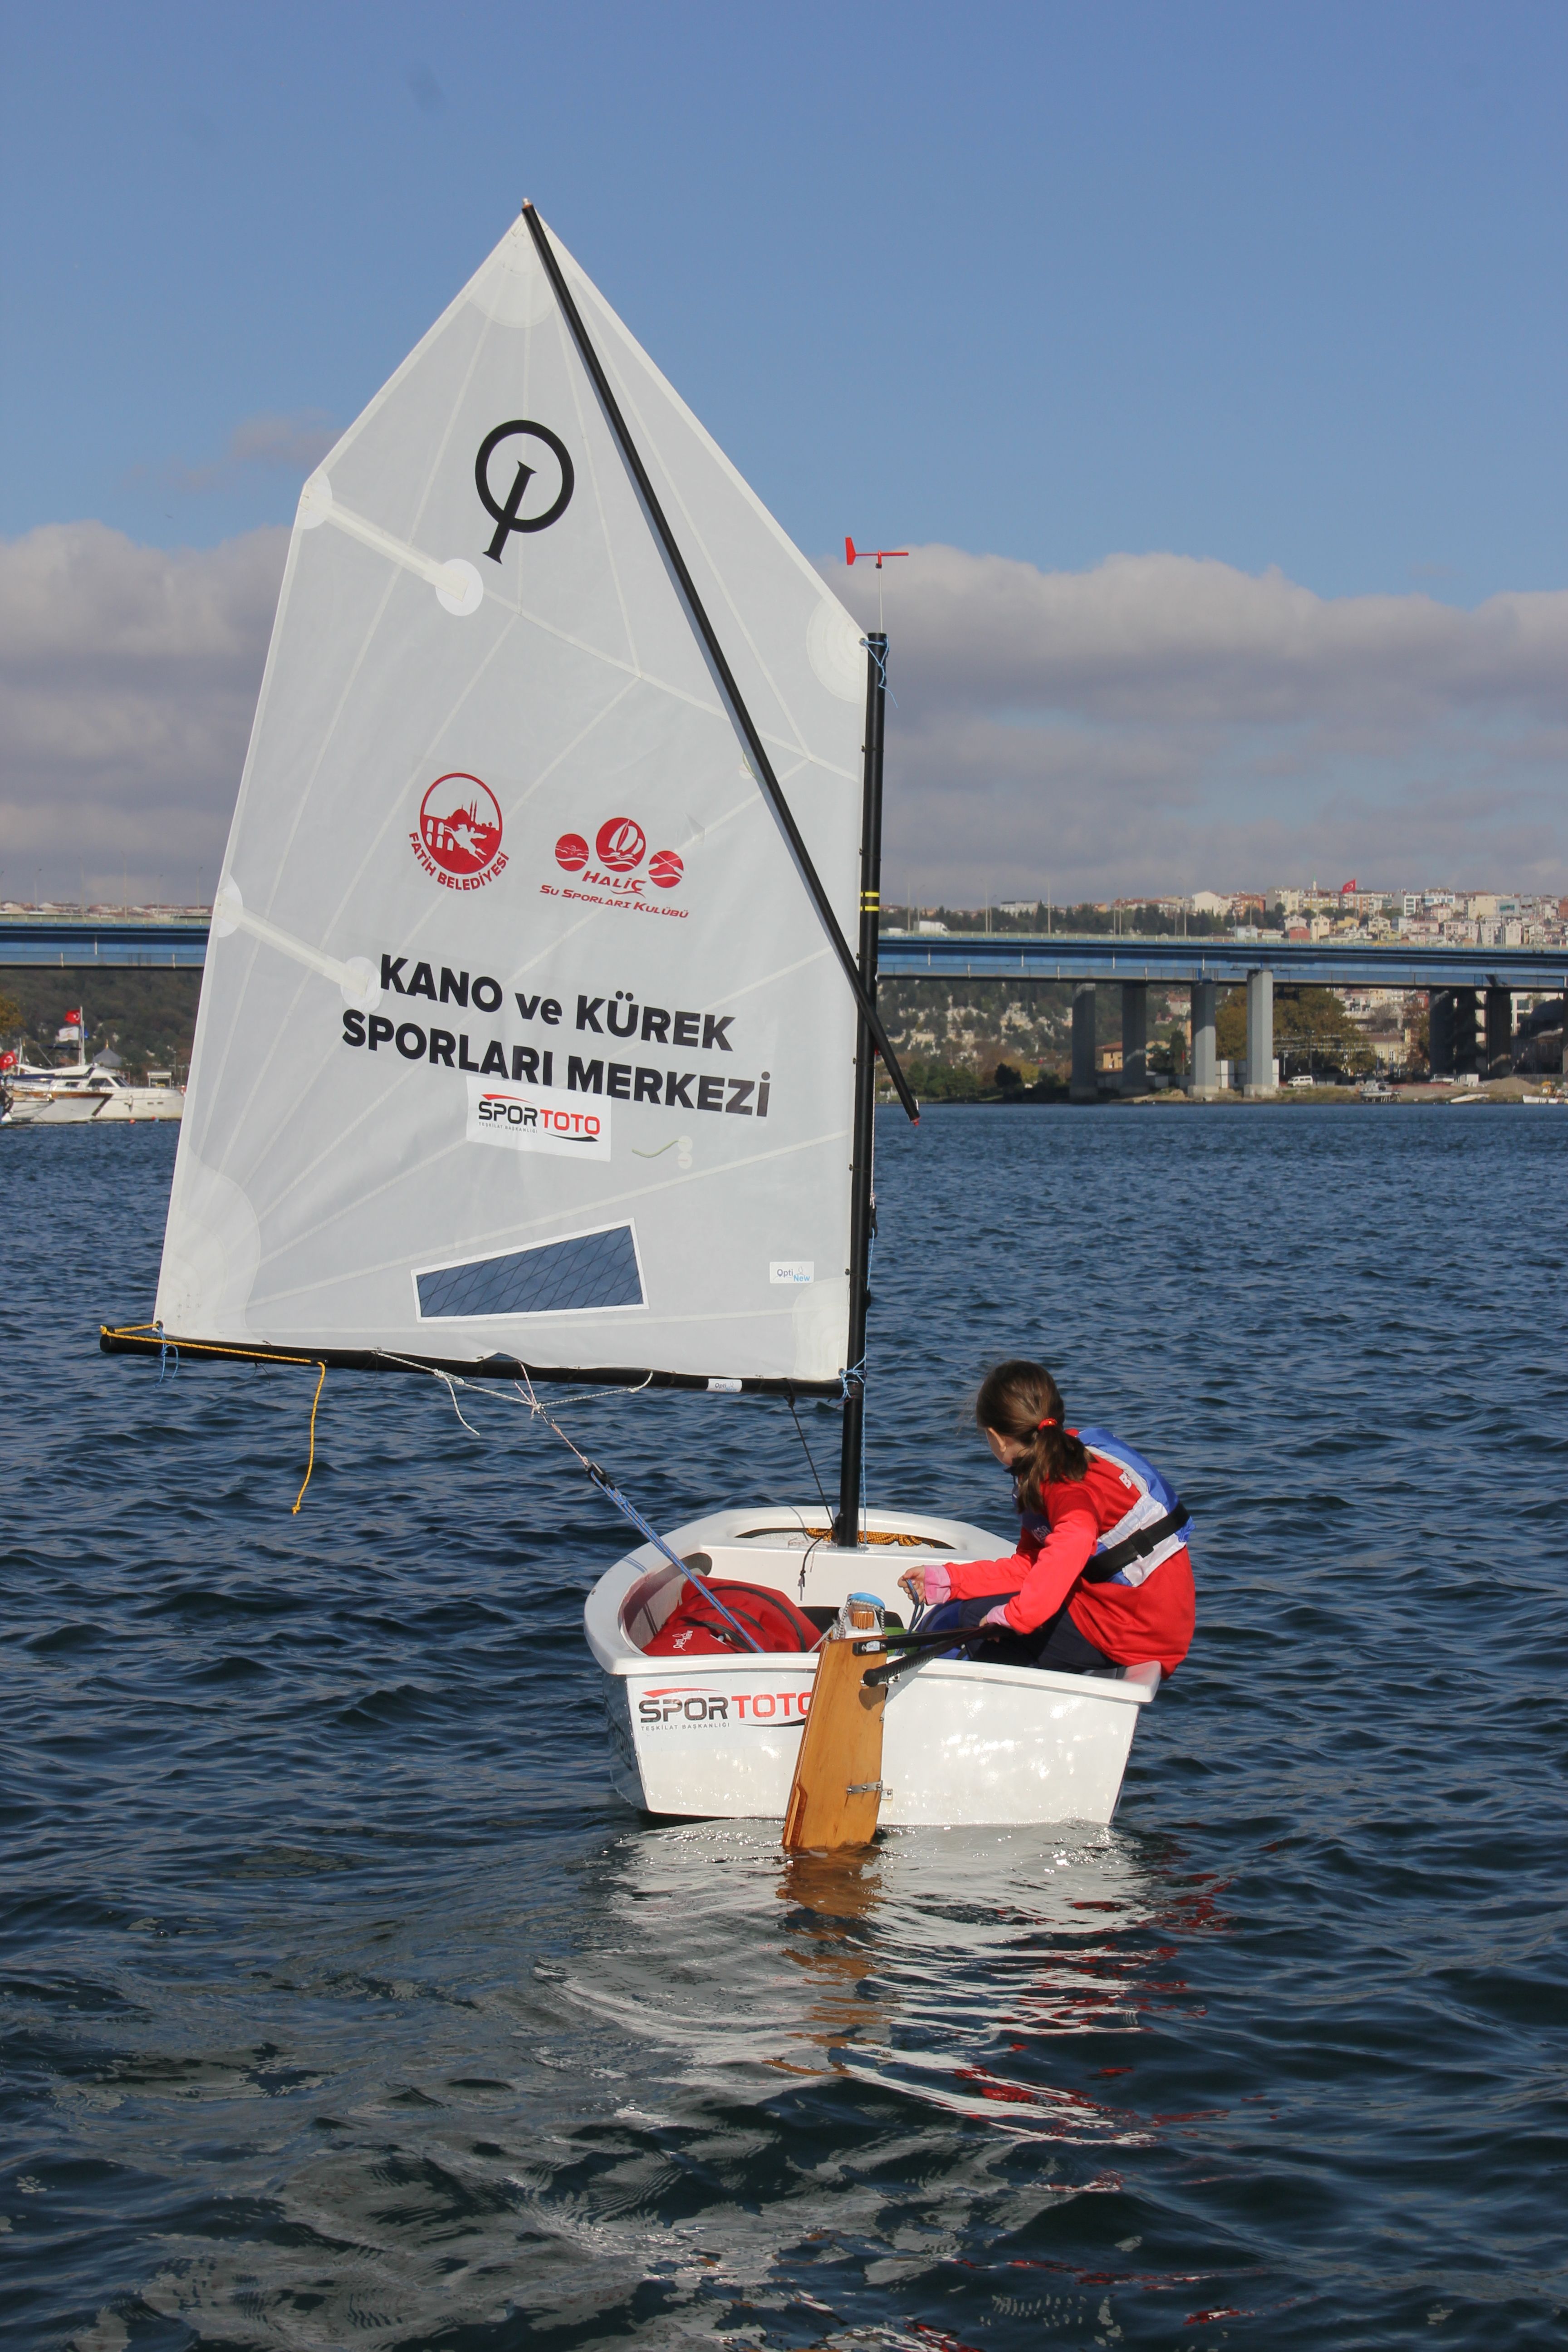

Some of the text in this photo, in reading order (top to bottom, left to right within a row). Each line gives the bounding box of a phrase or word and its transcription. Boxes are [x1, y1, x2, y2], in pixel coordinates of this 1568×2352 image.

[409, 832, 510, 891] FATİH BELEDİYESİ
[380, 953, 736, 1052] KANO ve KÜREK
[342, 1009, 770, 1117] SPORLARI MERKEZİ
[505, 1125, 538, 1134] BAŞKANLIĞI
[682, 1722, 730, 1730] BAŞKANLIĞI
